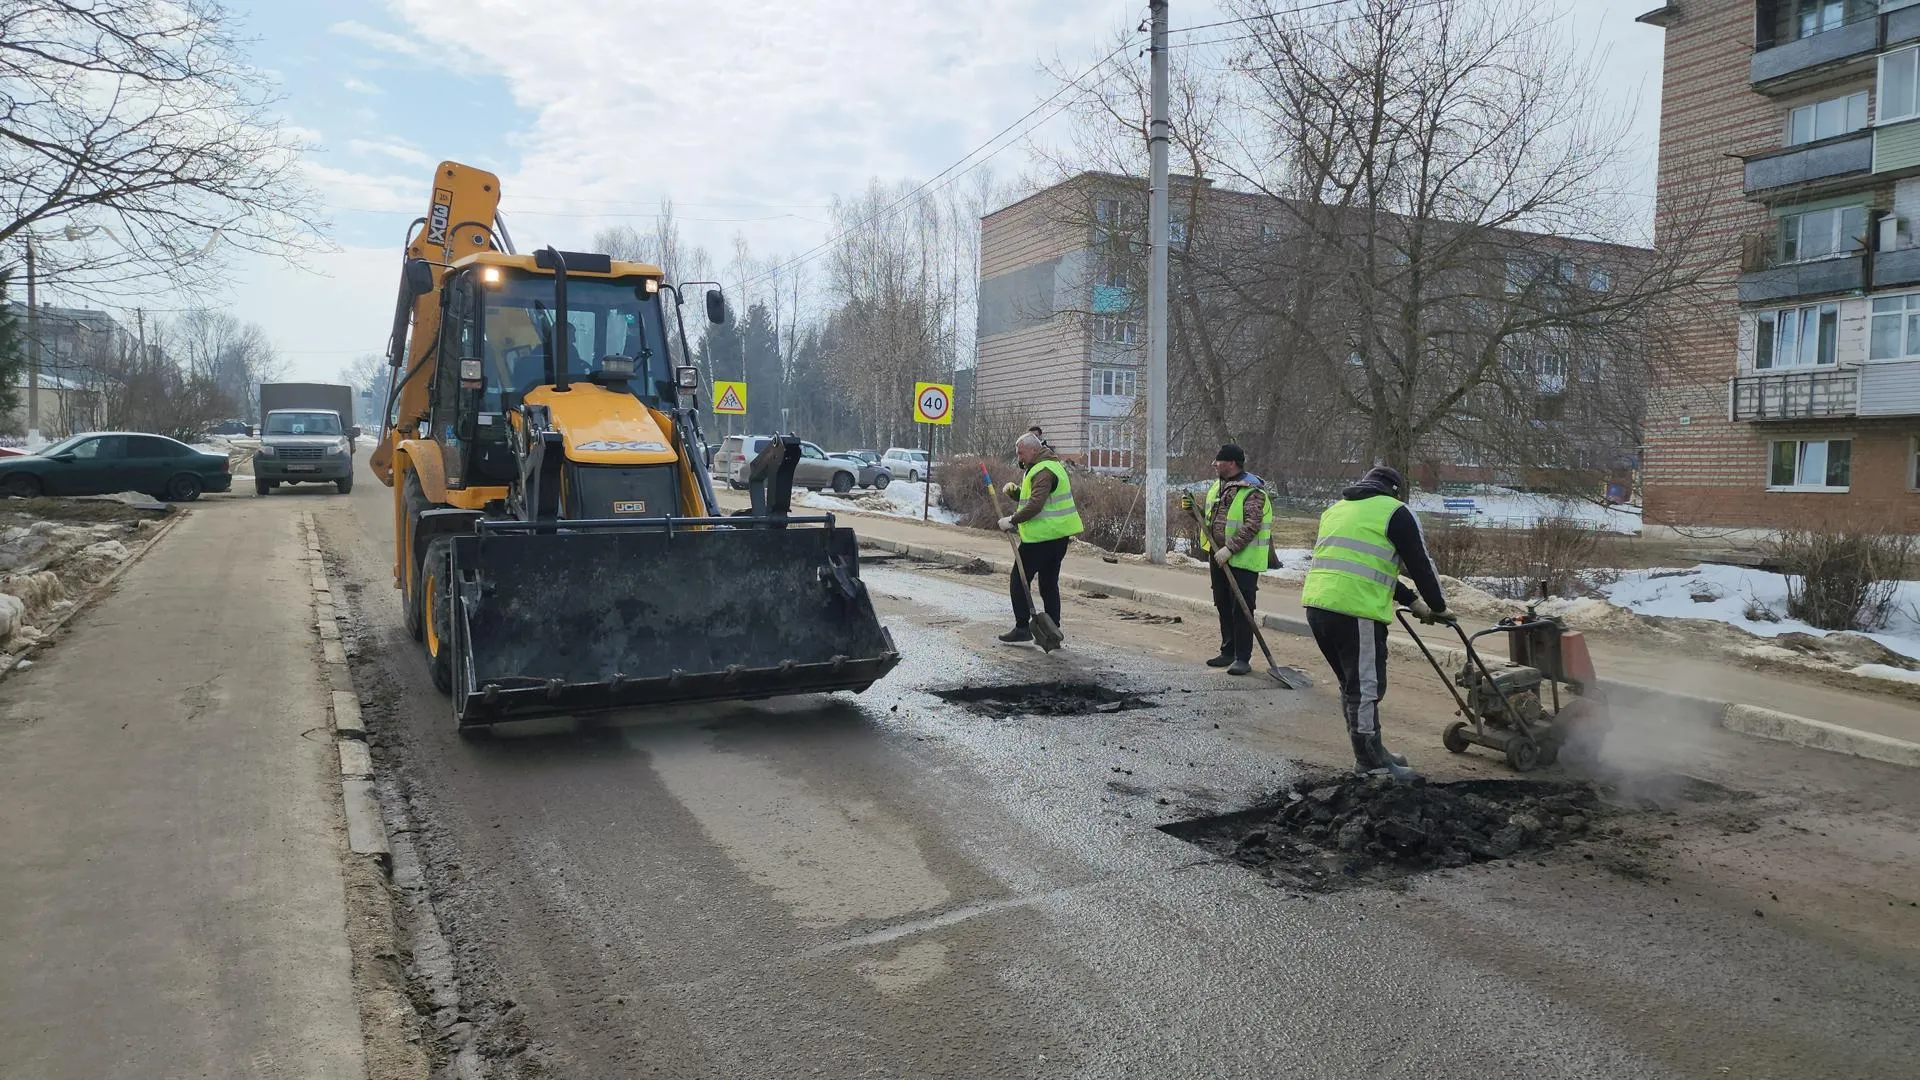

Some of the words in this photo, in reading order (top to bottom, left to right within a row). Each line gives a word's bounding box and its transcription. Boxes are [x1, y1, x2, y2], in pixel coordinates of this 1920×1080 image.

[428, 204, 449, 241] 3DX
[924, 396, 943, 410] 40
[616, 503, 643, 511] JCB
